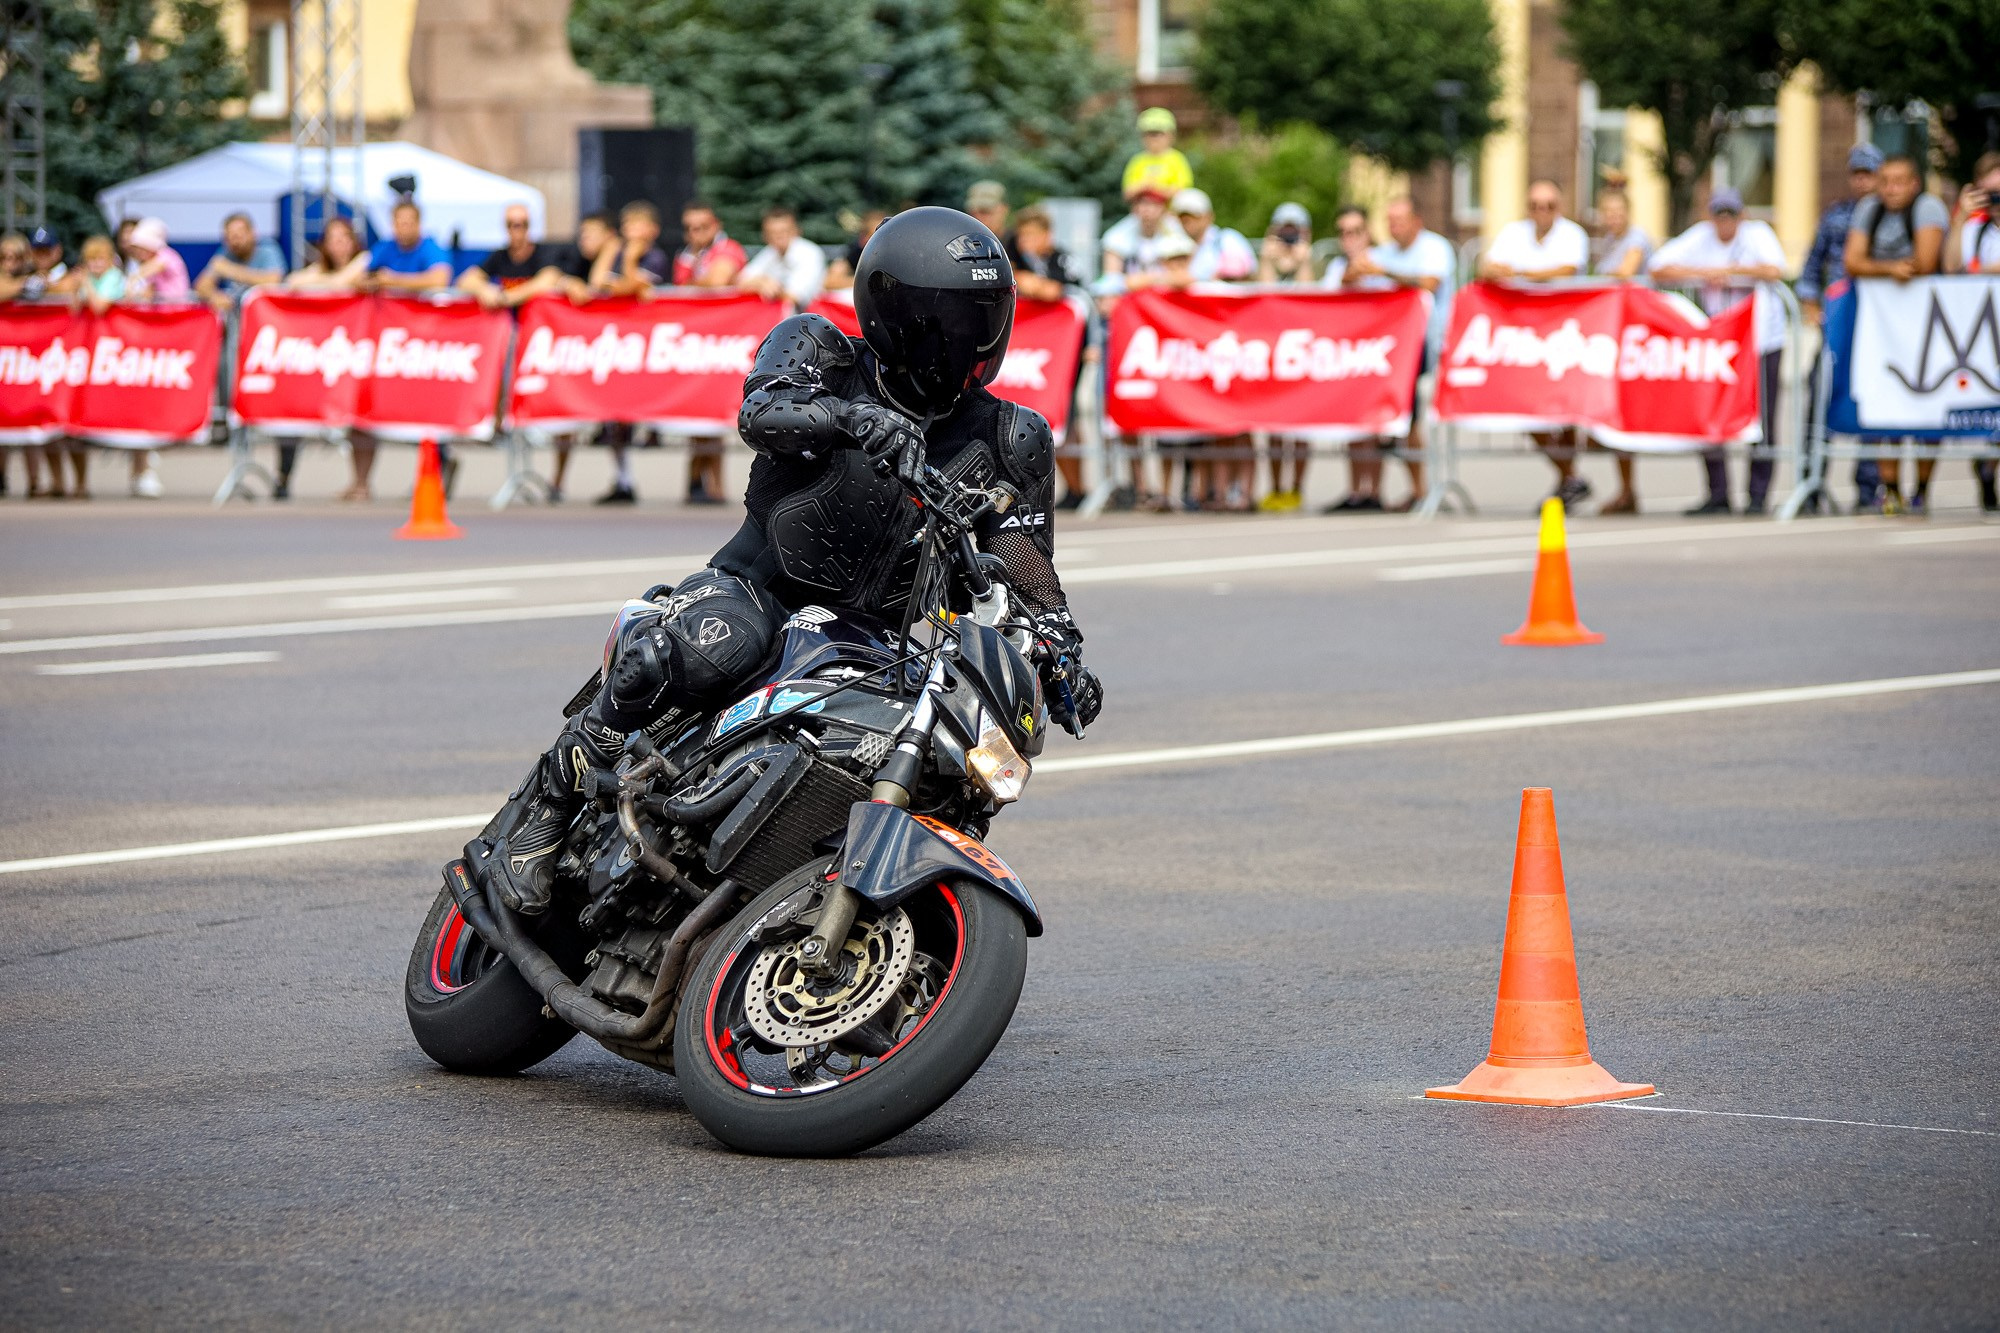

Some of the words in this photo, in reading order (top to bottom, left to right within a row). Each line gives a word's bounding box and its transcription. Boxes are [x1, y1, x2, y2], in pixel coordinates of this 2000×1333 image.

[0, 336, 90, 395] льфа
[90, 336, 196, 390] Банк
[244, 325, 376, 387] Альфа
[375, 327, 482, 383] Банк
[518, 325, 647, 385] Альфа
[646, 322, 758, 374] Банк
[1118, 325, 1271, 394] Альфа
[1272, 328, 1398, 381] Банк
[1450, 313, 1618, 381] Альфа
[1618, 323, 1740, 384] Банк
[999, 512, 1046, 529] ACE
[780, 619, 822, 634] HONDA
[646, 707, 682, 734] NESS
